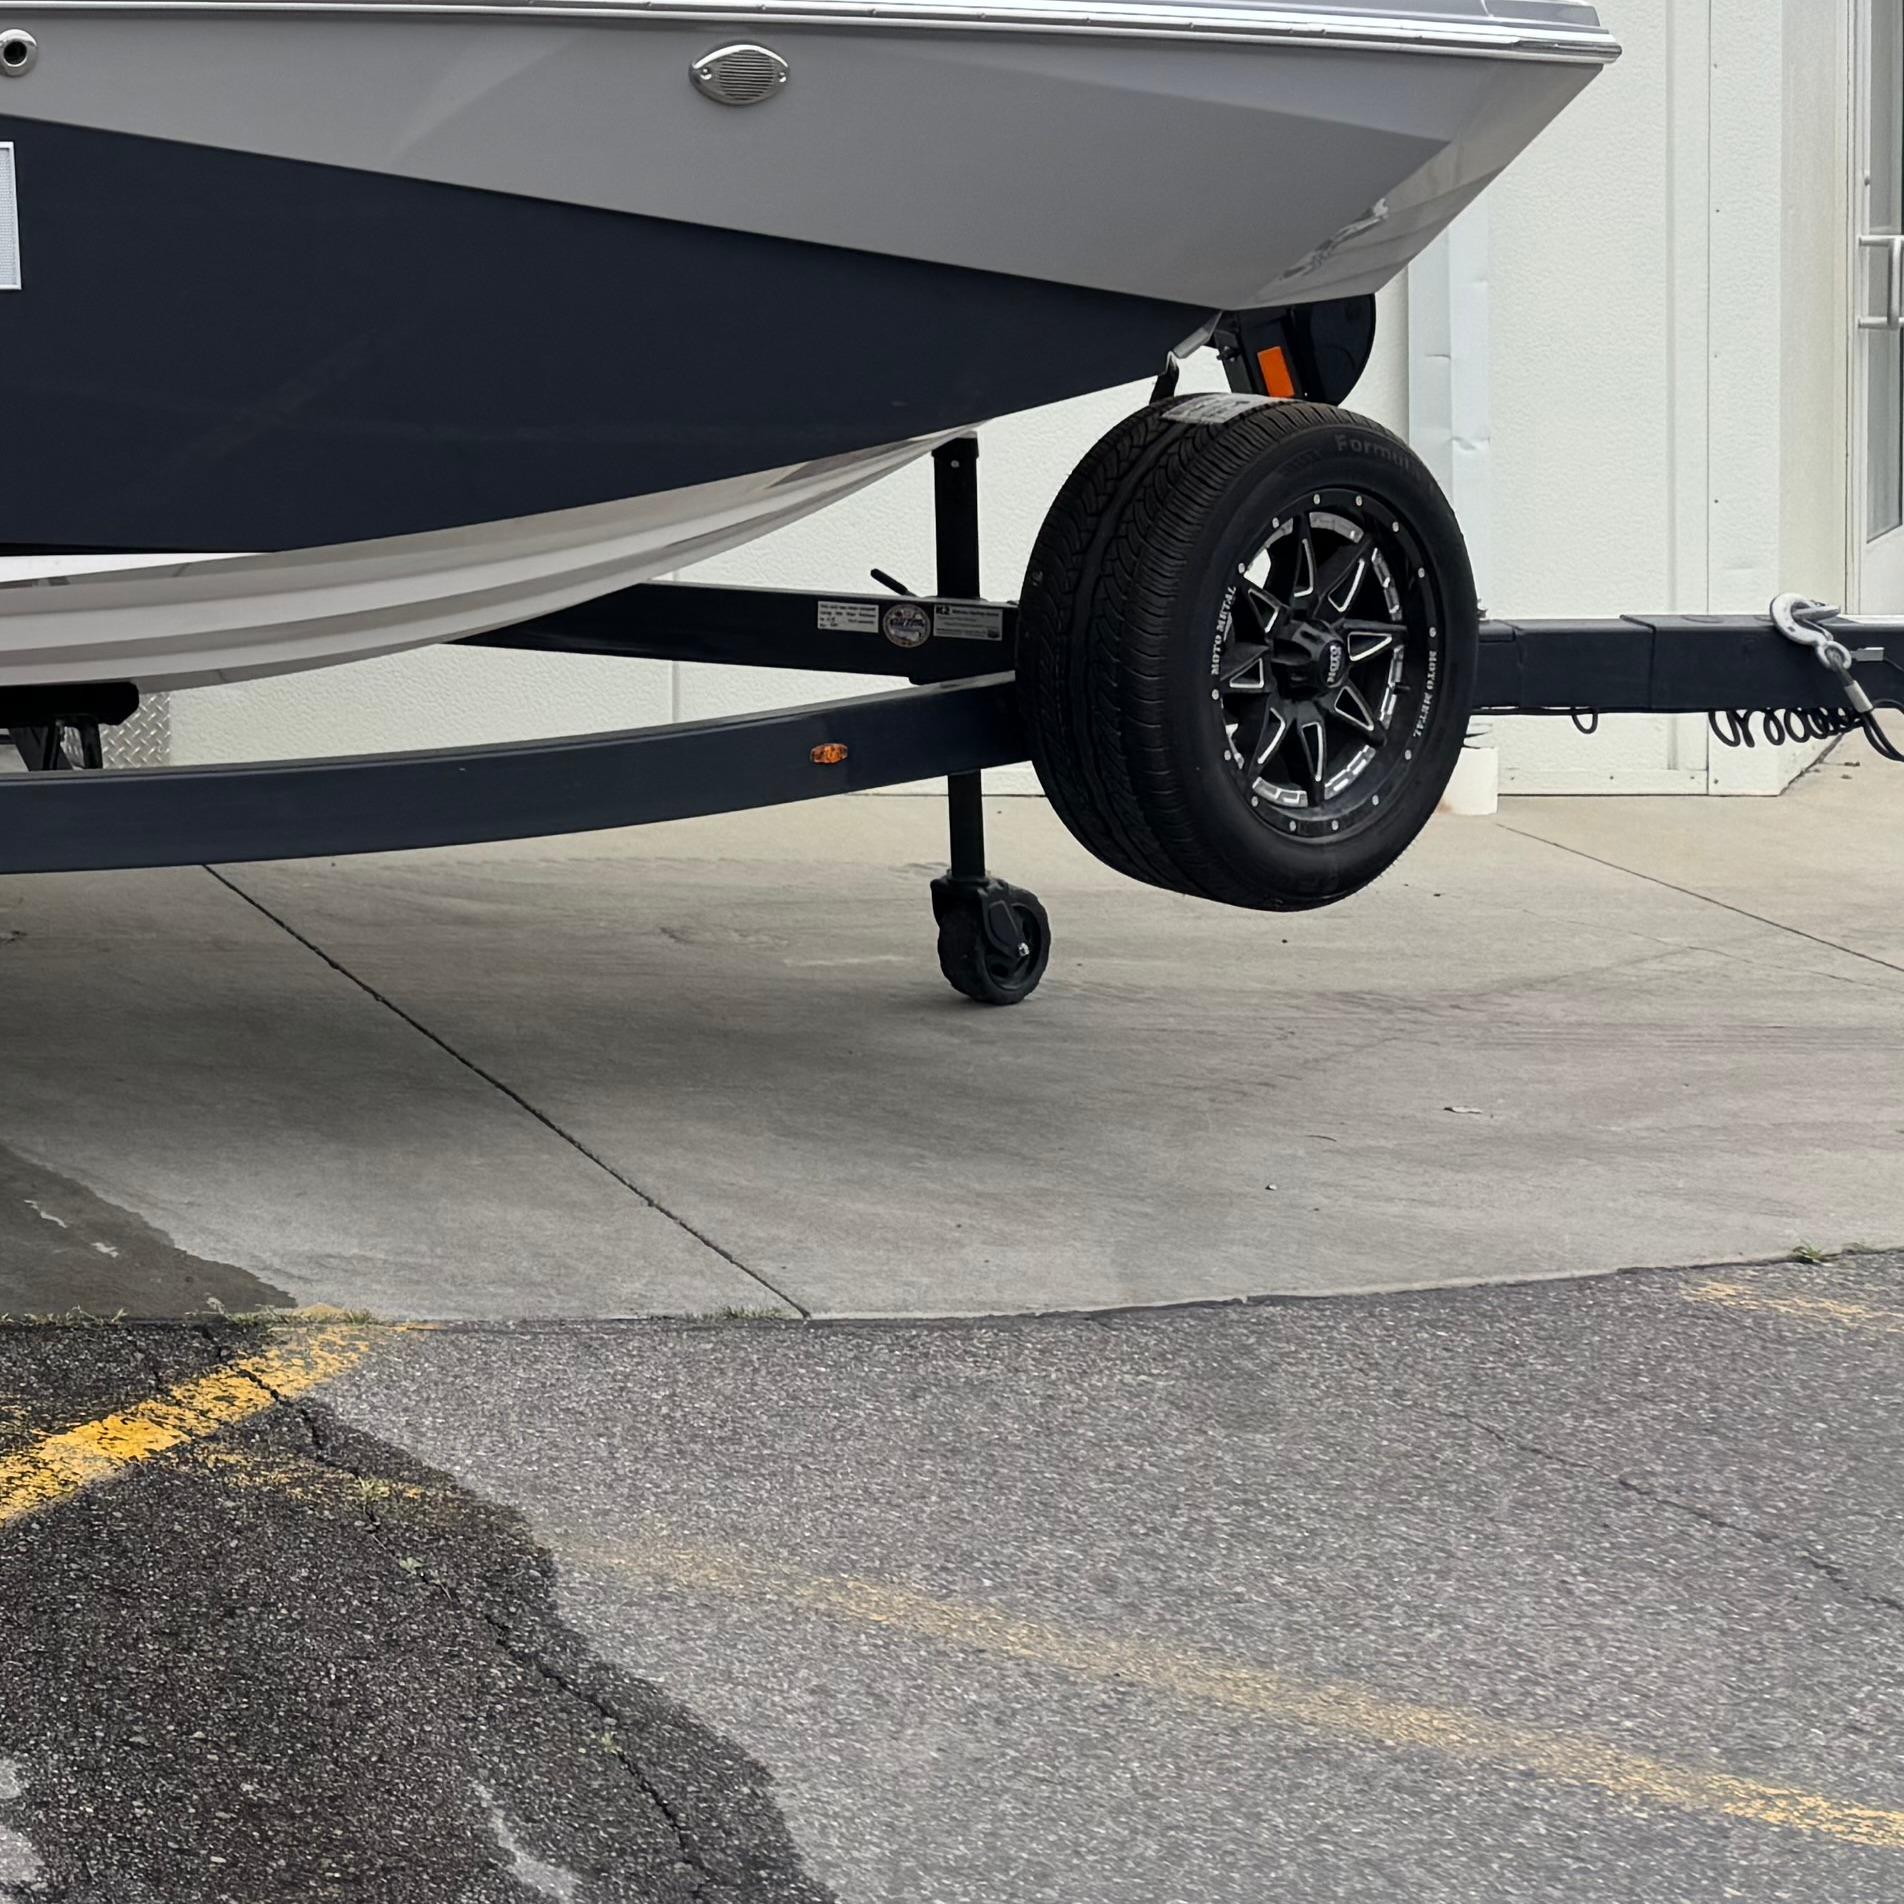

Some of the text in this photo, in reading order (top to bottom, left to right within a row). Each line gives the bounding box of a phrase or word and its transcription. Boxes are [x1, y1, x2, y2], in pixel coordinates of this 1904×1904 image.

[1211, 586, 1237, 675] MOTO METAL
[1413, 650, 1437, 737] MOTO METAL
